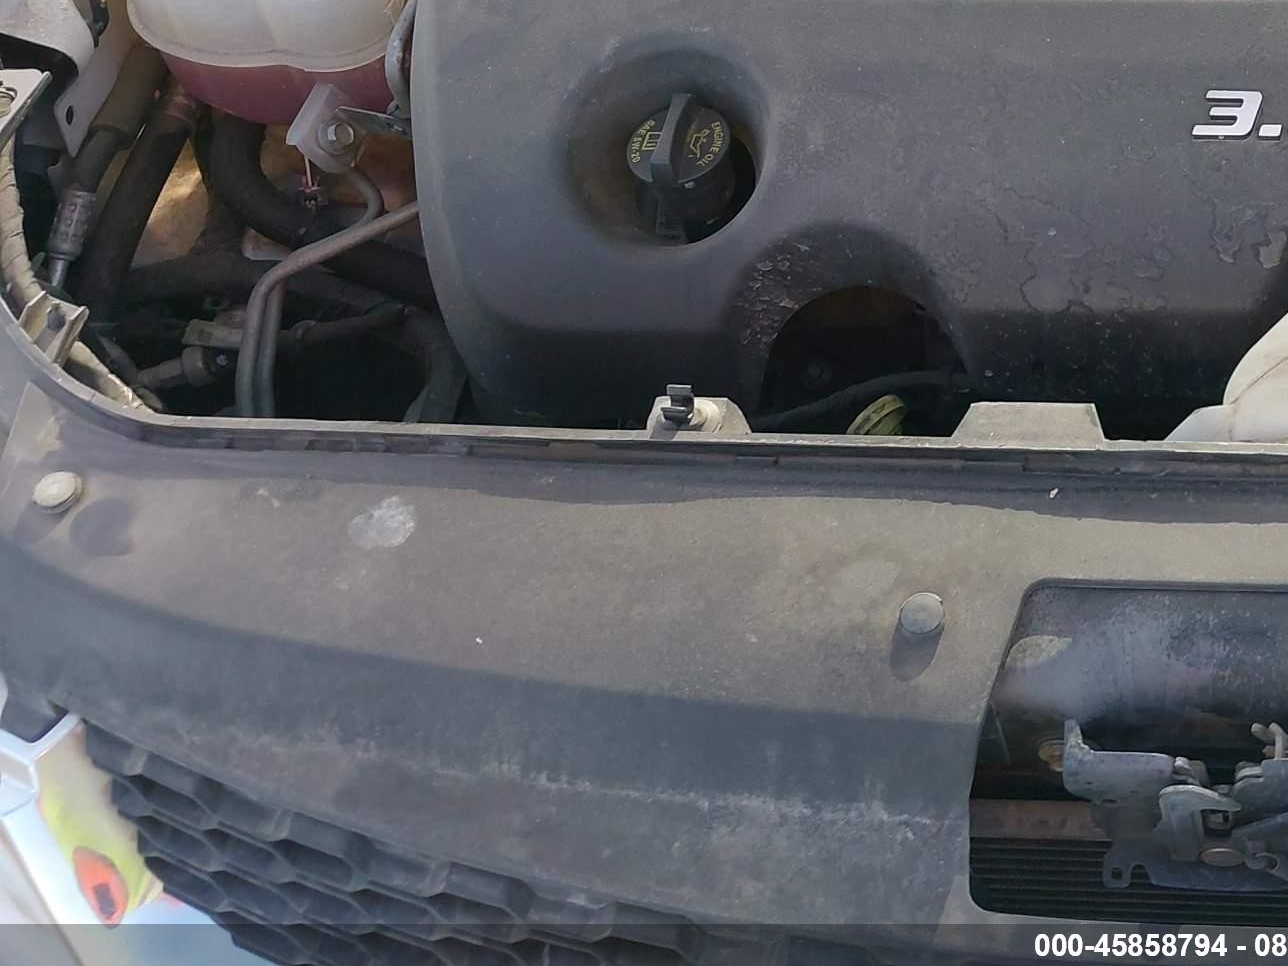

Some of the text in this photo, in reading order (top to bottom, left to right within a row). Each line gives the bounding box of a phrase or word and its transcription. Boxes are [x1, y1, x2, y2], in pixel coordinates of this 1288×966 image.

[630, 137, 641, 163] 5W-20
[695, 121, 721, 167] ENGINE OIL
